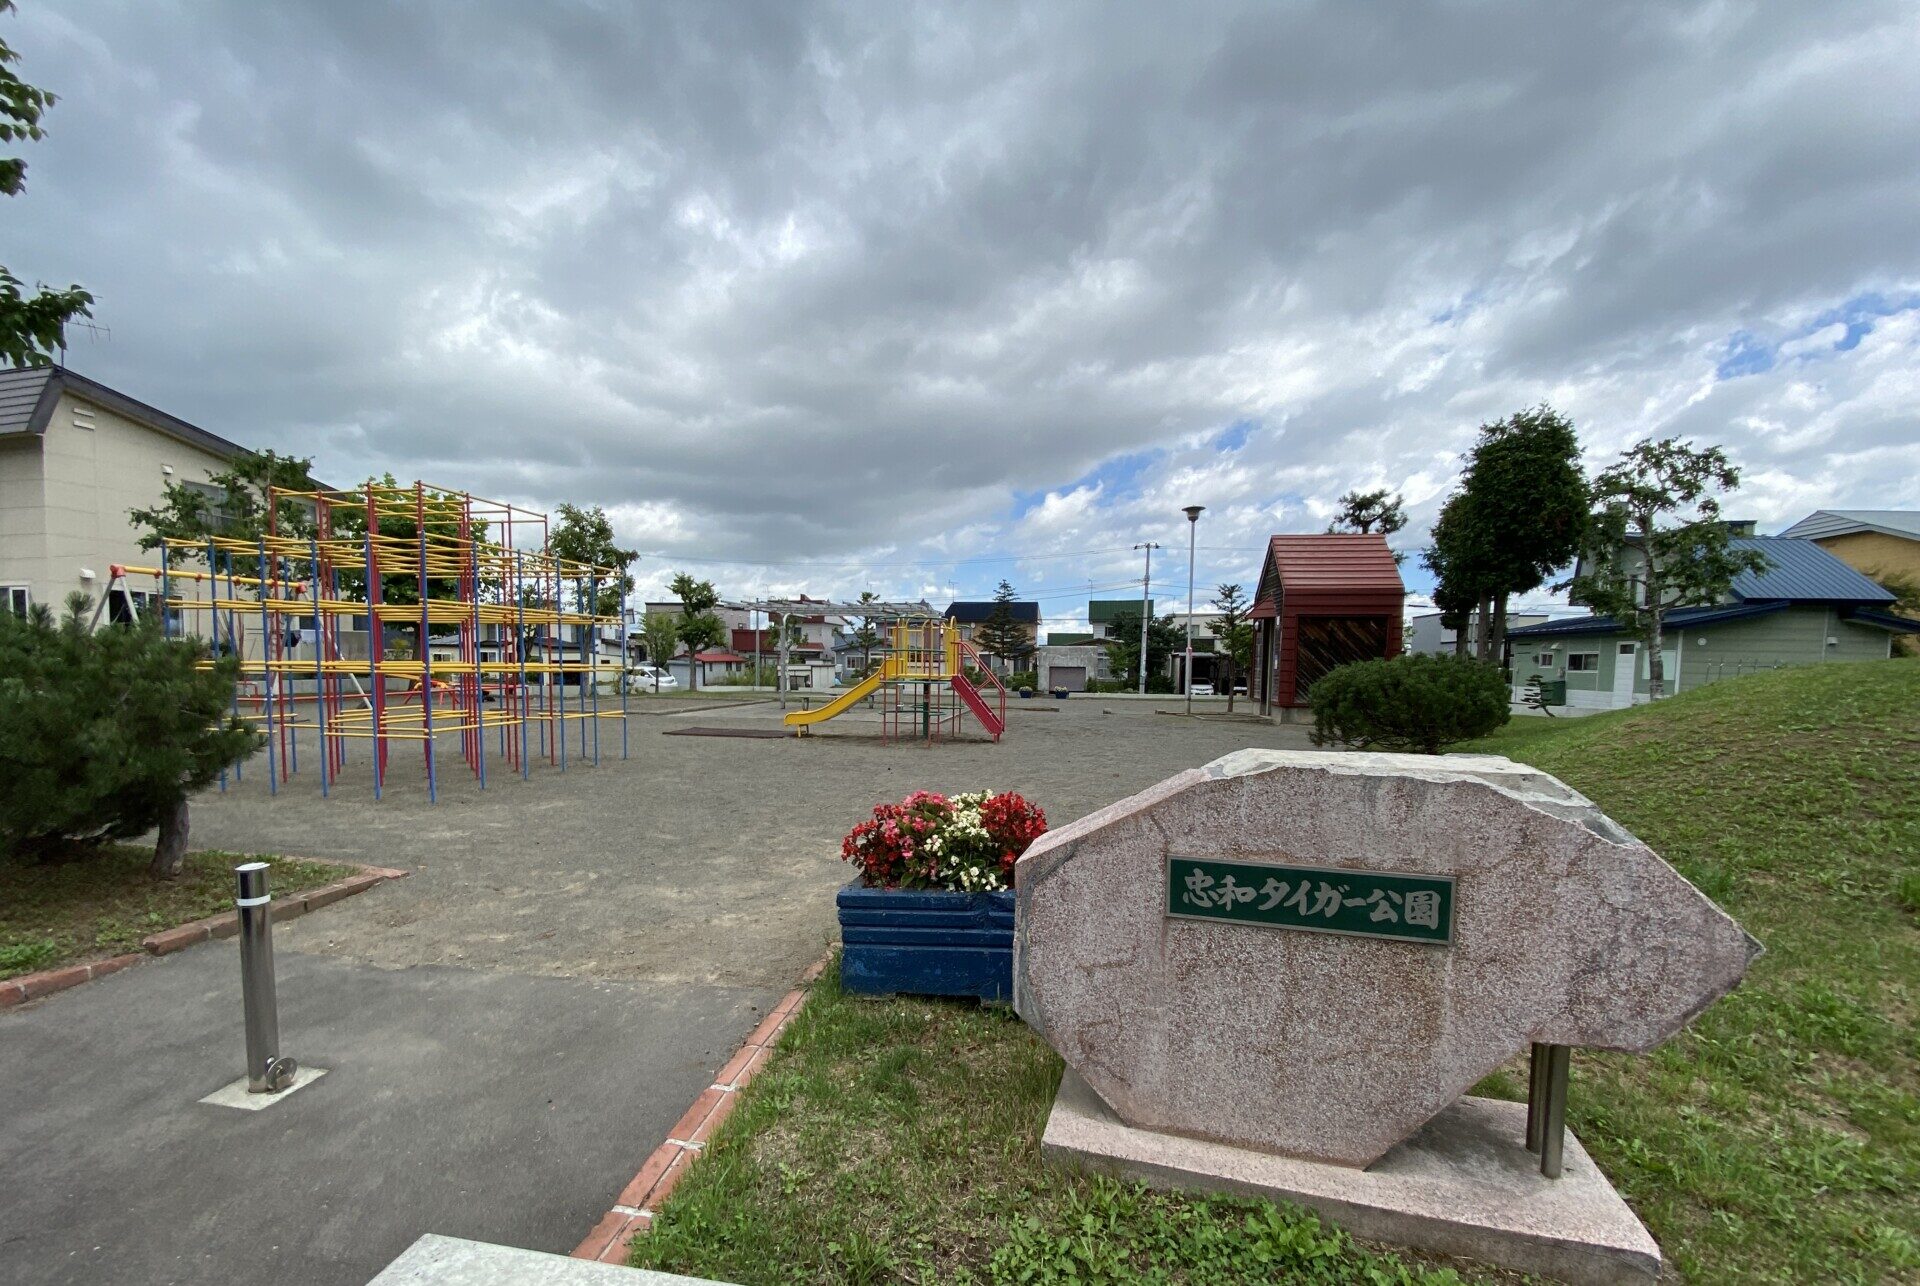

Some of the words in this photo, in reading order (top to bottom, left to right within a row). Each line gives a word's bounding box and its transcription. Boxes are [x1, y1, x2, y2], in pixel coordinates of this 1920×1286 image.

[1182, 868, 1442, 930] 忠和タイガー公園
